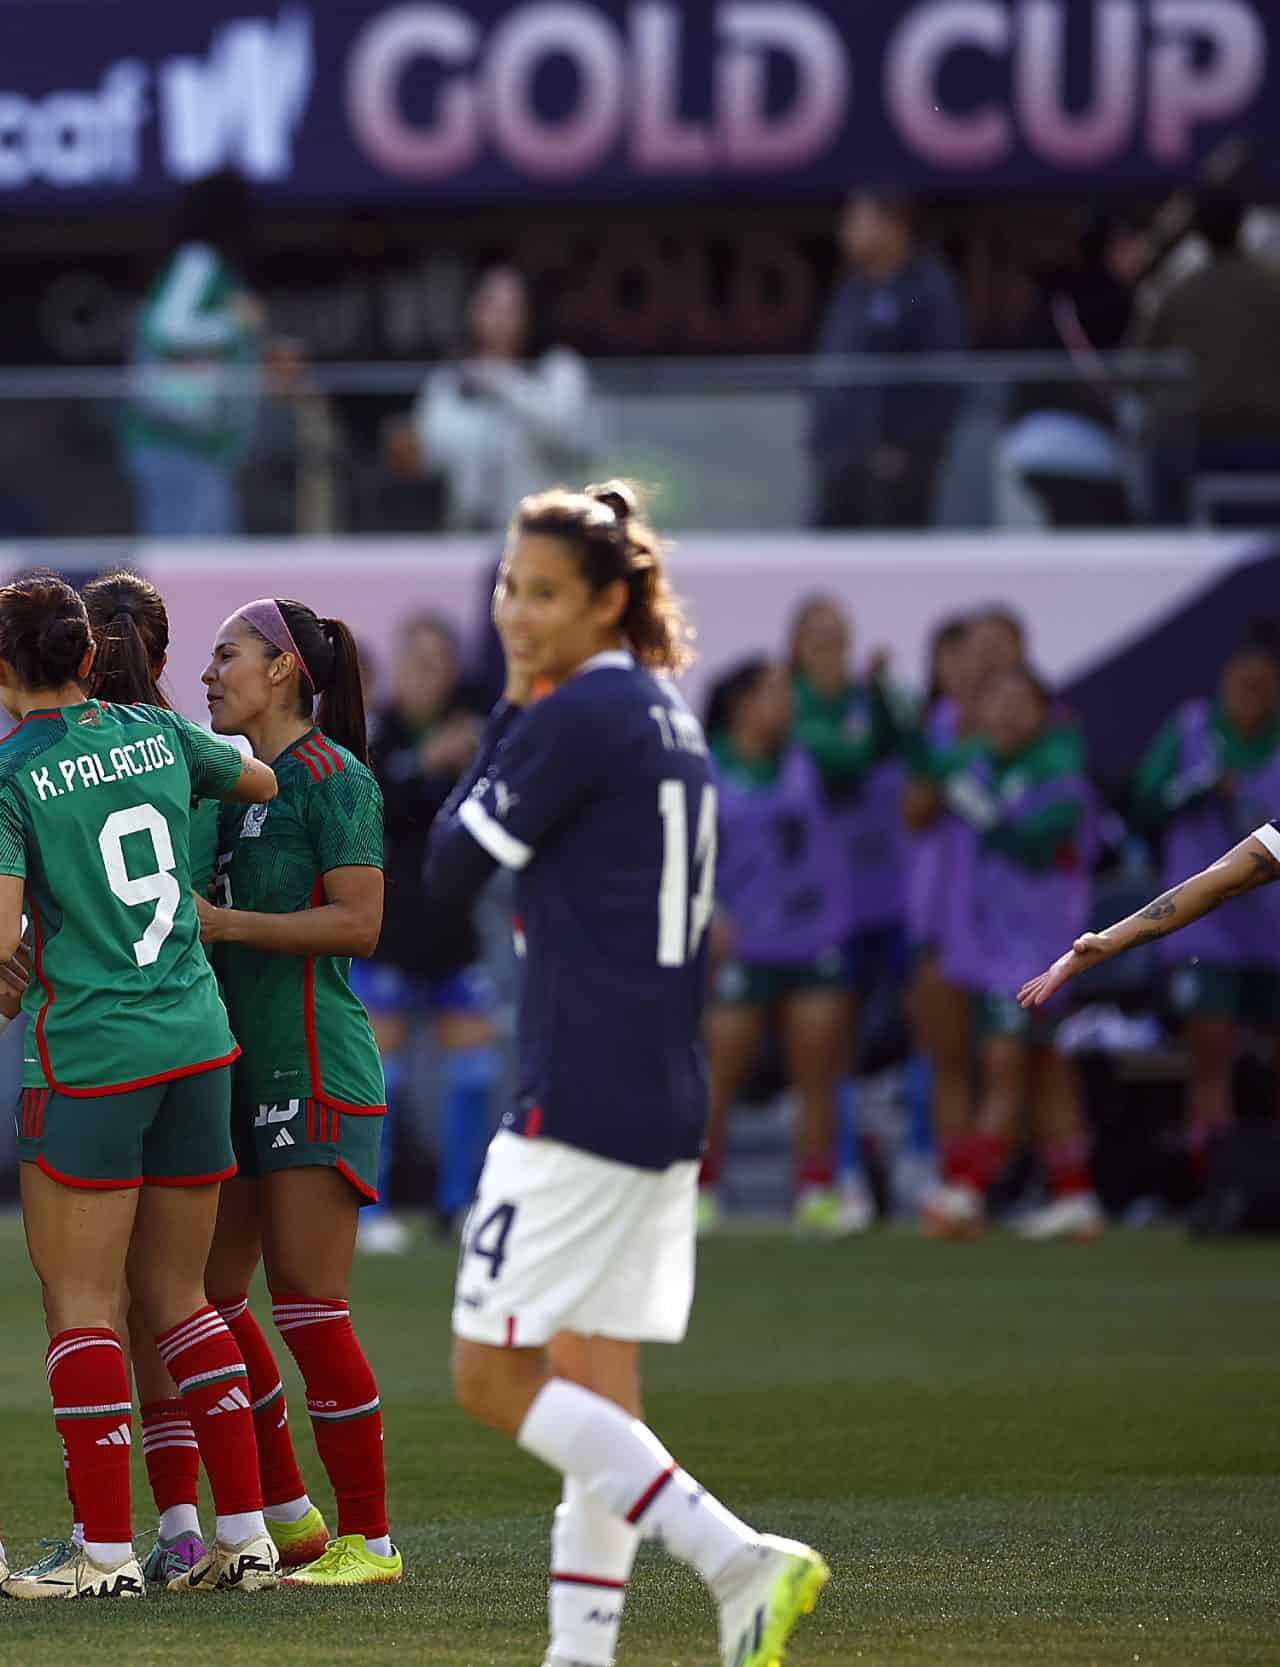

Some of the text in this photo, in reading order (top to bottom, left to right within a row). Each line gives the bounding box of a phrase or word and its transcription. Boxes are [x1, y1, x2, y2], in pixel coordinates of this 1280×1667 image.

[345, 0, 850, 180] GOLD
[883, 0, 1267, 168] CUP
[30, 734, 175, 801] K.PALACIOS
[98, 803, 180, 967] 9
